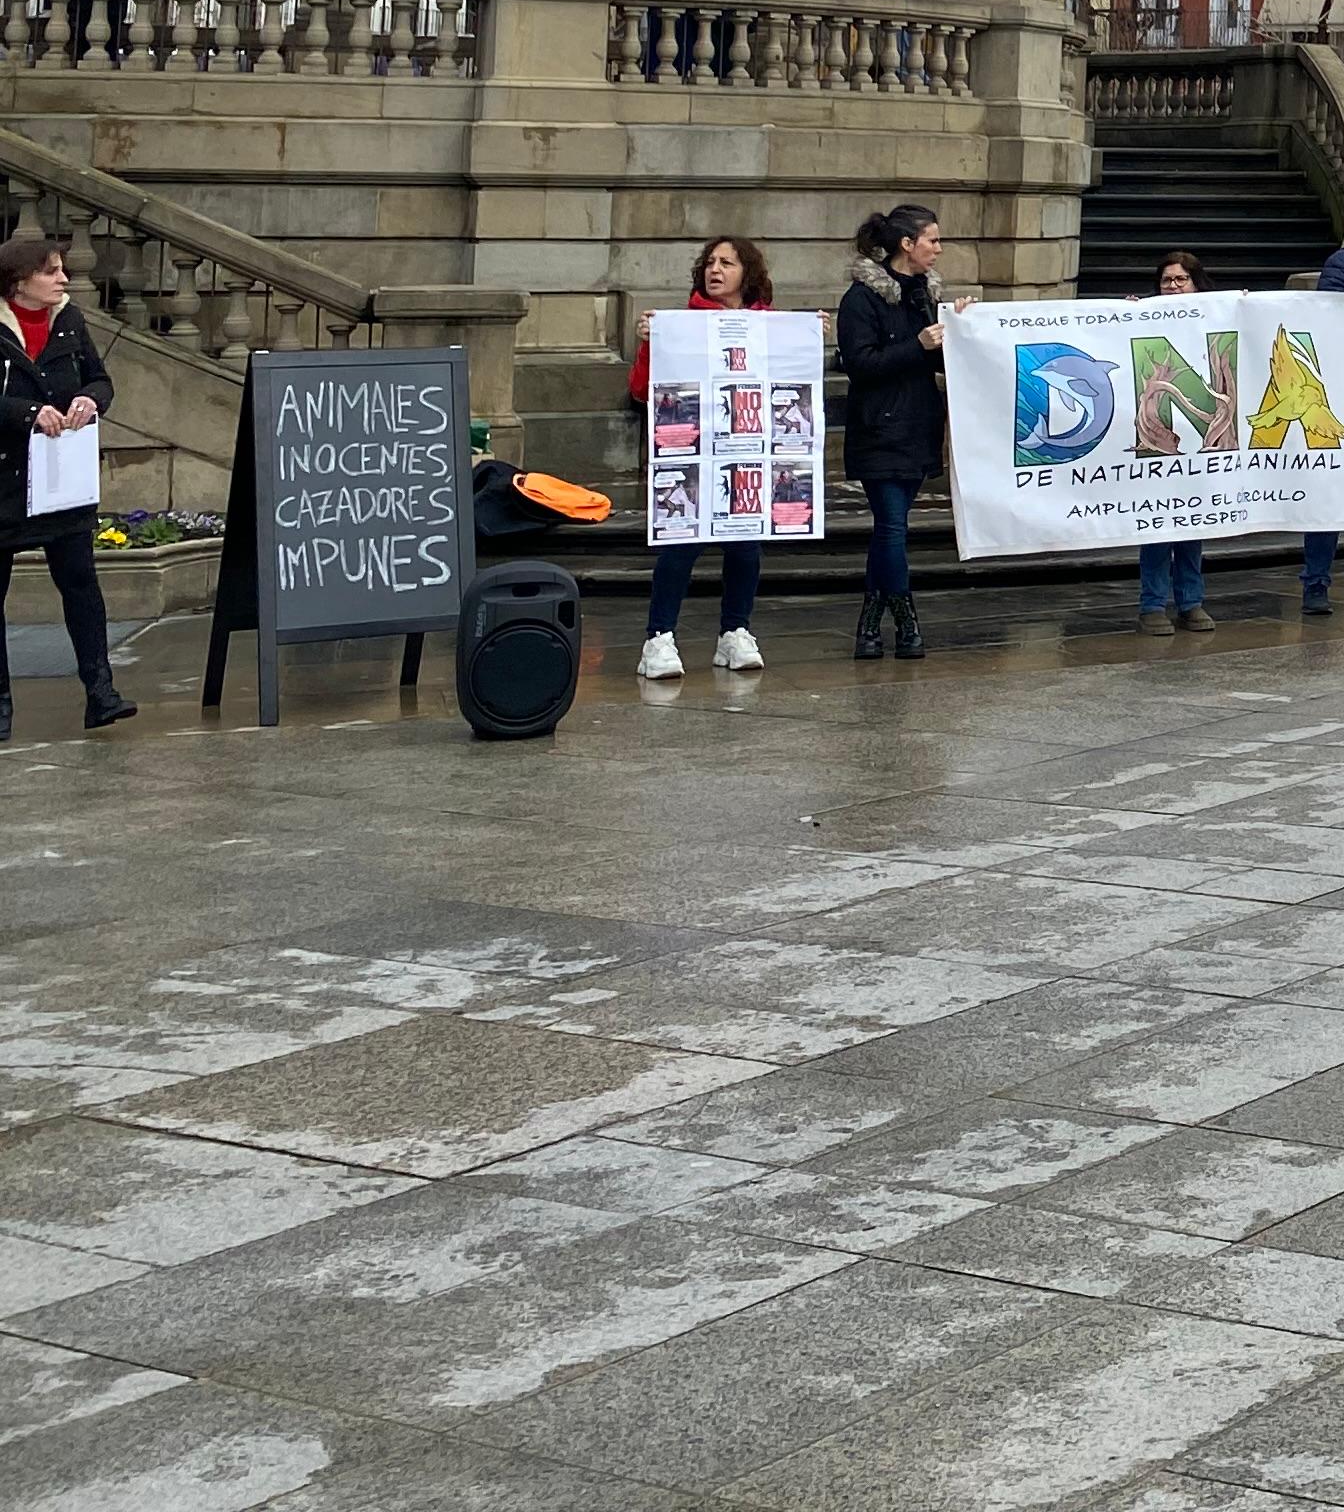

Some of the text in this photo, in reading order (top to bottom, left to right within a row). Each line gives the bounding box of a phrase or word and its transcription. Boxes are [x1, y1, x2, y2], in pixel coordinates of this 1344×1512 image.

[999, 316, 1070, 328] PORQUE
[1074, 312, 1133, 326] TODAS
[276, 380, 448, 440] ANIMALES
[1015, 452, 1342, 489] DE NATURALEZA ANIMAL
[275, 485, 454, 529] CAZADORES
[1066, 495, 1203, 519] AMPLIANDO
[1211, 493, 1232, 506] EL
[1136, 509, 1248, 531] DE RESPETO
[278, 535, 451, 592] IMPUNES
